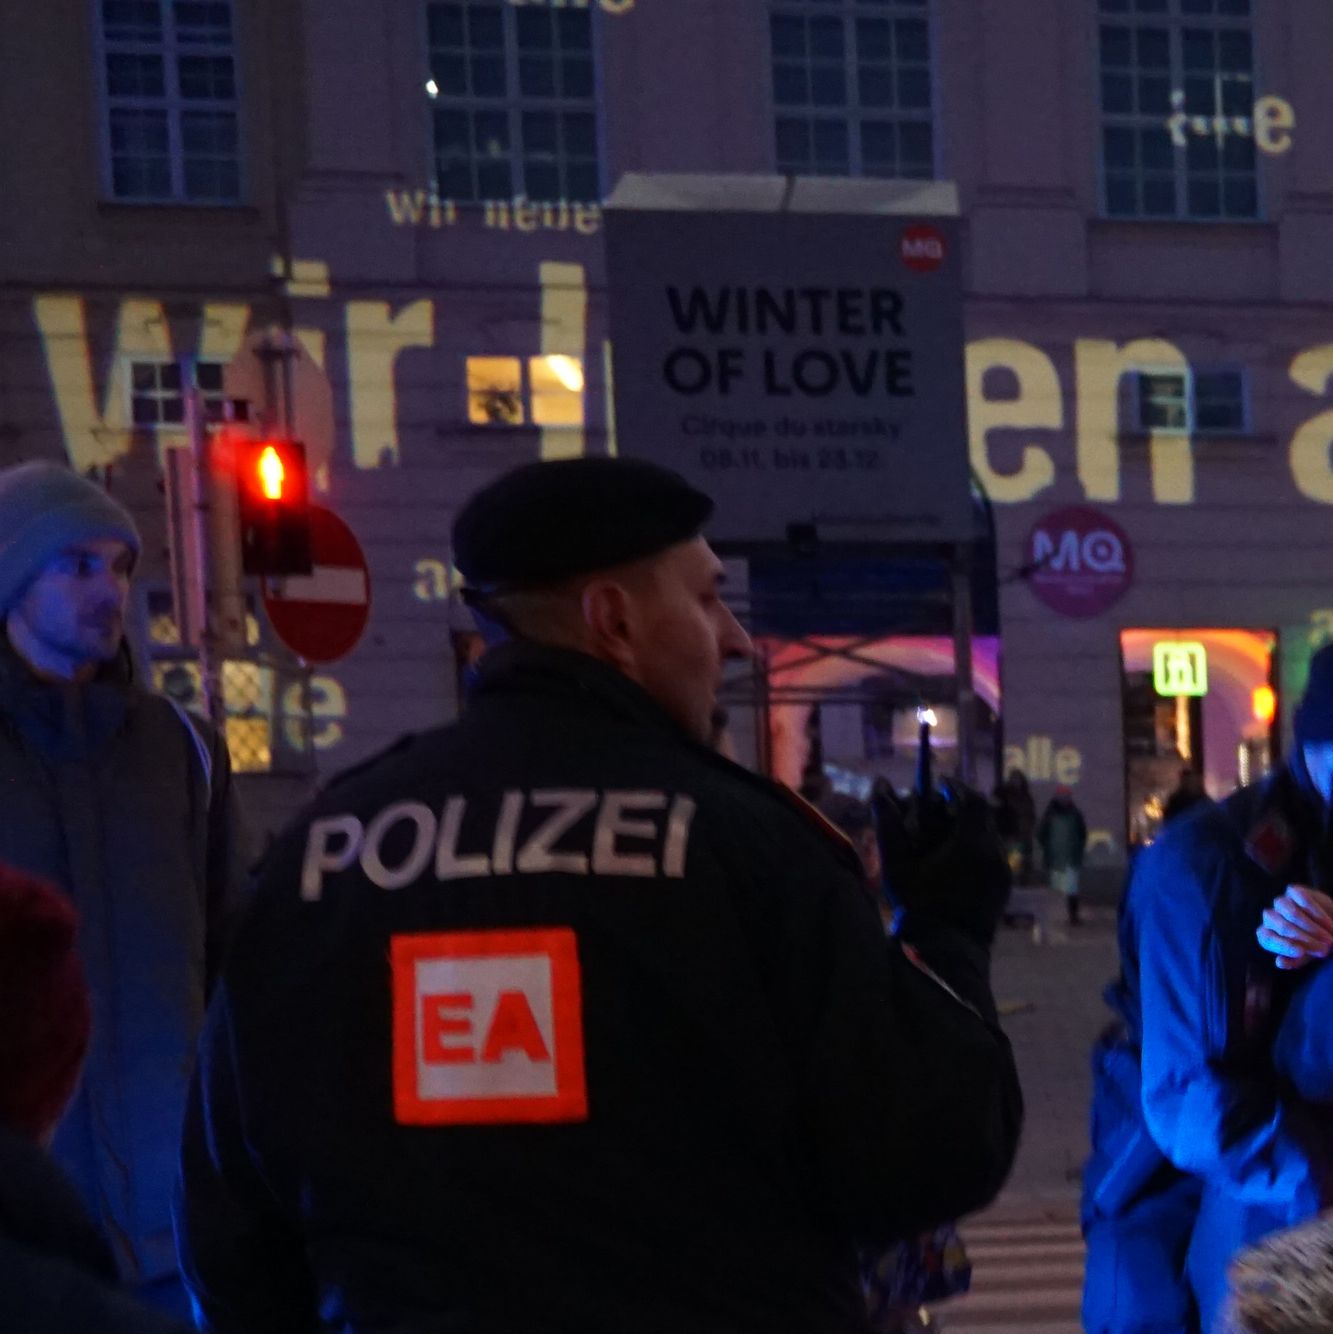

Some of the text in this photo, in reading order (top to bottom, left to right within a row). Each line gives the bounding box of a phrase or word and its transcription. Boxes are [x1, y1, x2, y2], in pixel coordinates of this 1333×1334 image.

[664, 286, 906, 336] WINTER
[663, 346, 915, 397] OF LOVE
[1031, 529, 1127, 573] MQ
[300, 787, 697, 902] POLIZEI
[421, 990, 550, 1066] EA
